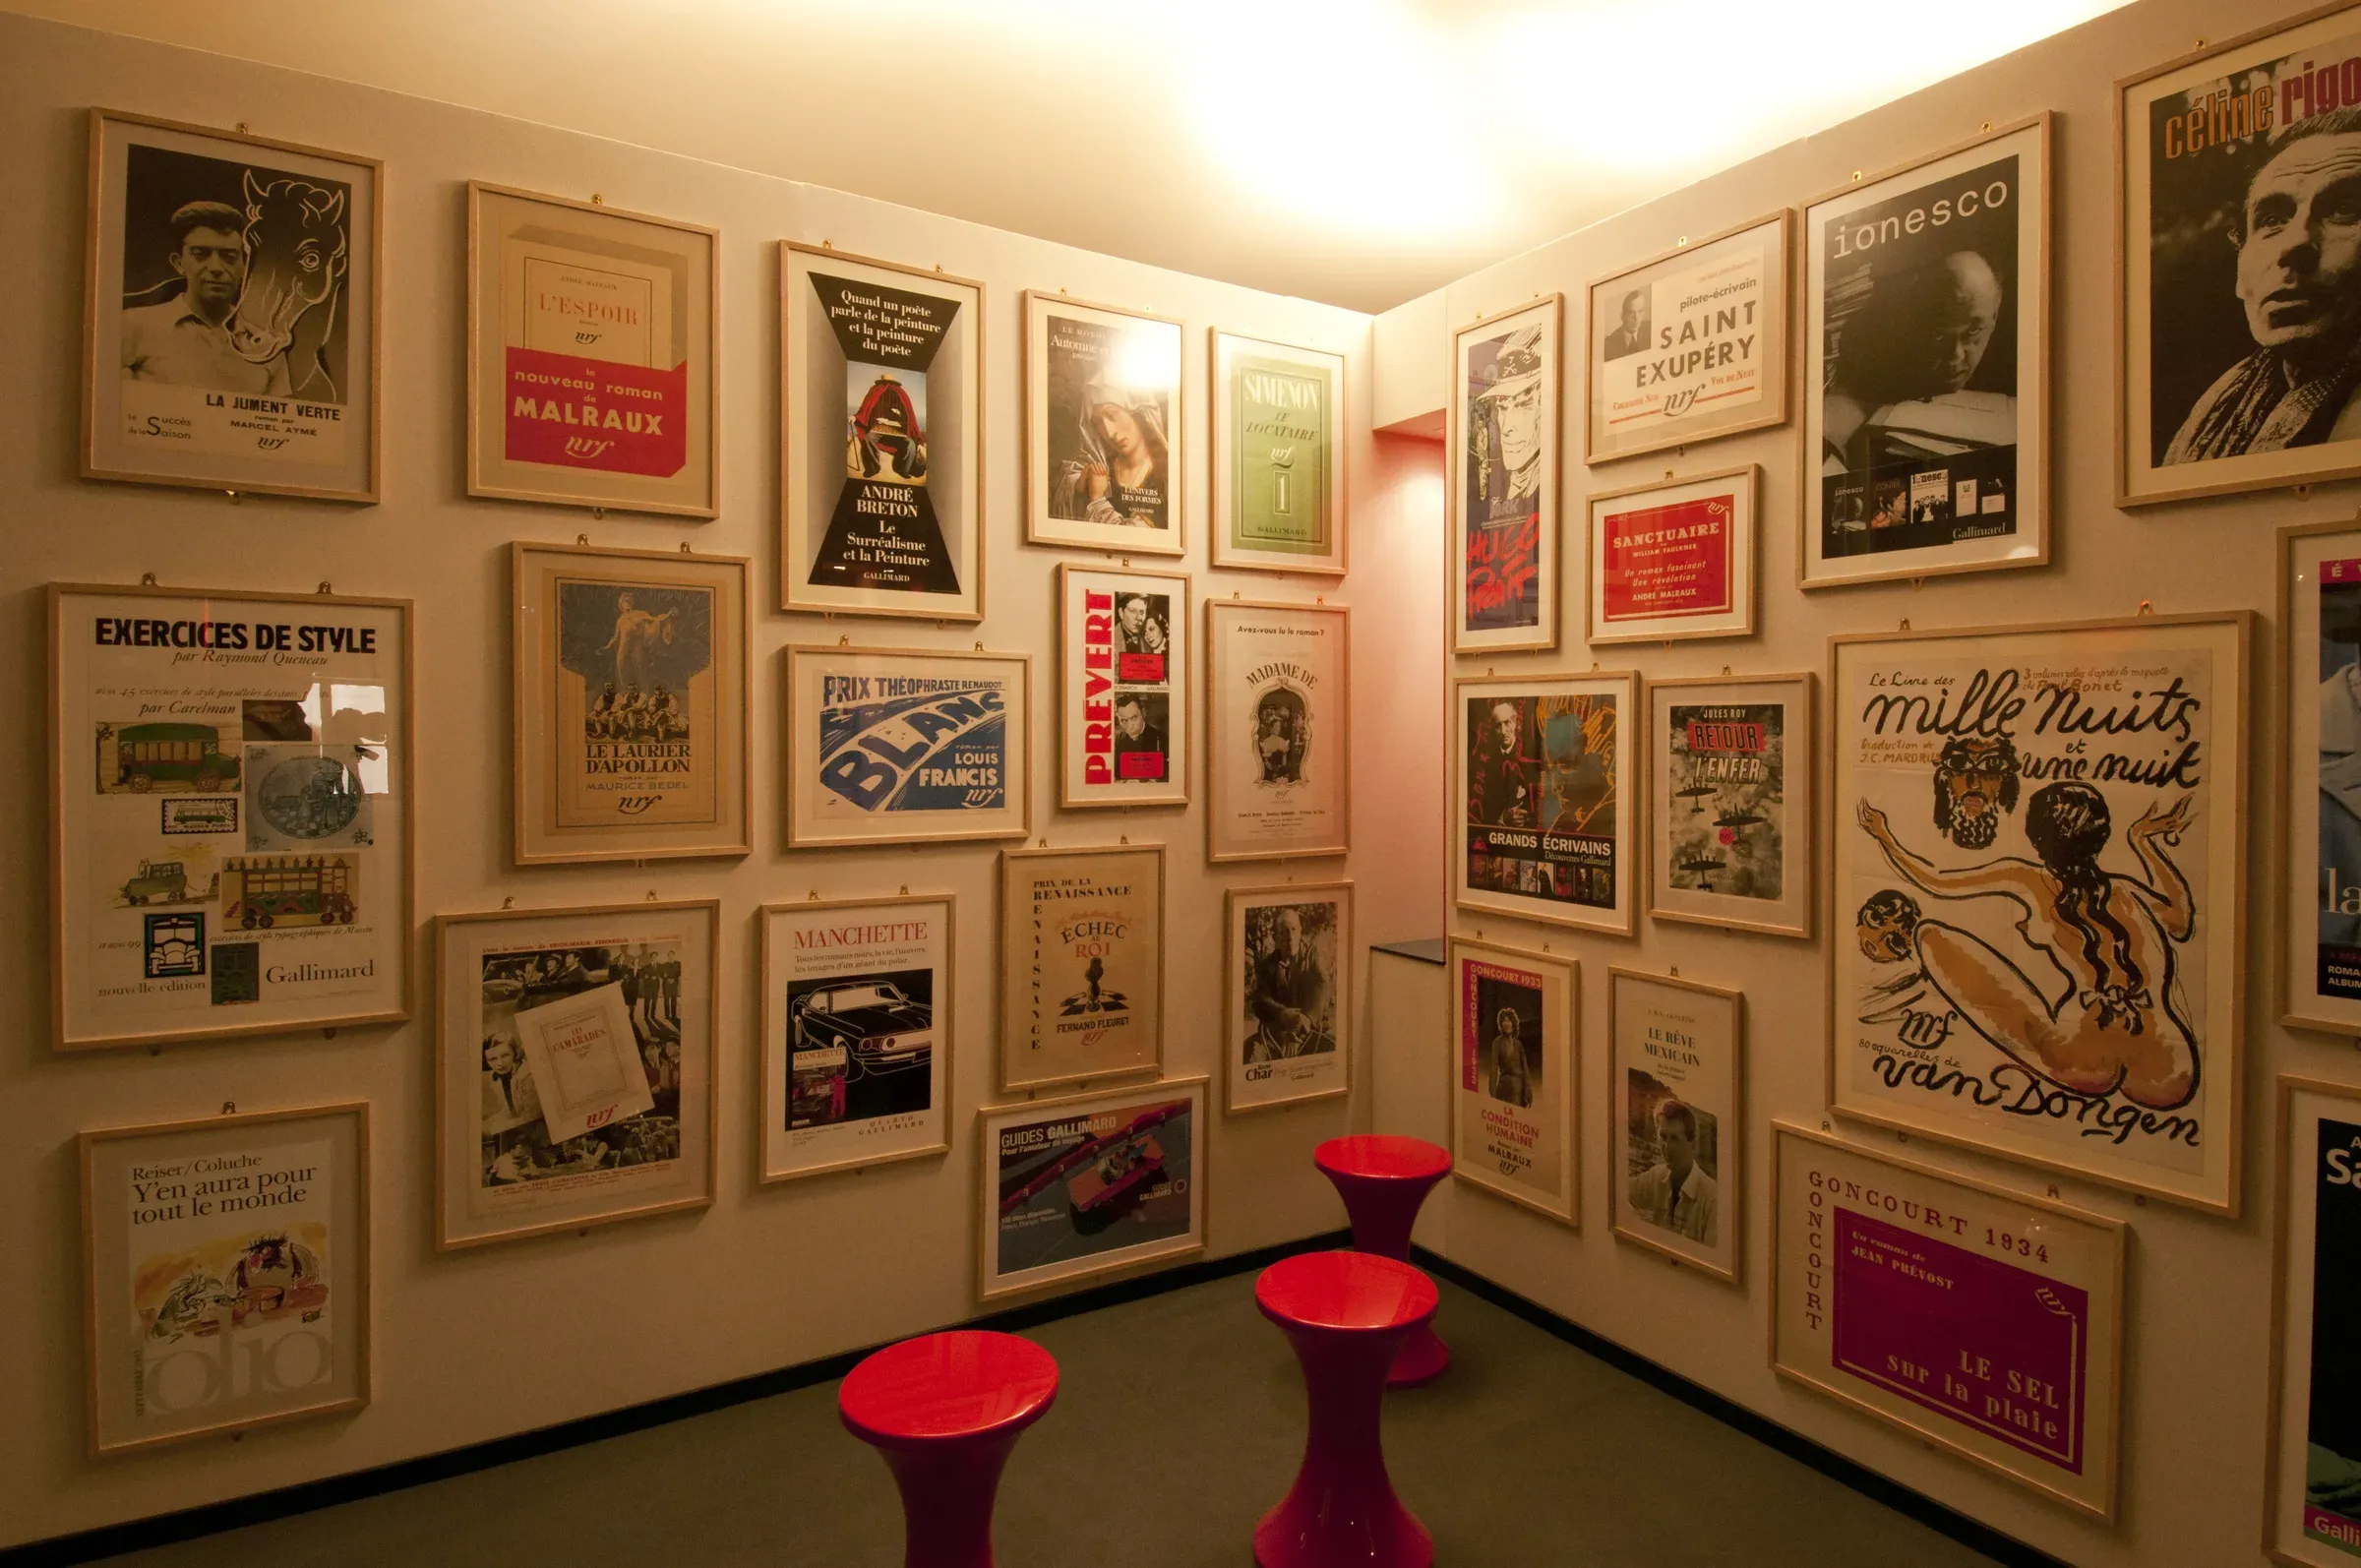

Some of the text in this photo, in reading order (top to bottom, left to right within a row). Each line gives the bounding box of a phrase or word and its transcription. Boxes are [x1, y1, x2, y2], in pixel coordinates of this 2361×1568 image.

[2165, 85, 2273, 159] céline
[1834, 181, 2008, 259] ionesco
[841, 289, 932, 321] Quand un poète
[1679, 277, 1757, 313] pilote-écrivain
[539, 293, 637, 327] L'ESPOIR
[830, 304, 941, 334] parle de la peinture
[849, 322, 925, 345] et la peinture
[1660, 300, 1756, 350] SAINT
[575, 332, 602, 345] nrf
[862, 339, 912, 358] du poète
[1636, 334, 1756, 389] EXUPÉRY
[515, 371, 664, 401] nouveau roman
[1244, 373, 1318, 411] SIMENON
[206, 393, 341, 421] LA JUMENT VERTE
[582, 394, 597, 403] de
[1664, 383, 1707, 417] nrf
[513, 395, 664, 436] MALRAUX
[1275, 412, 1291, 422] LE
[230, 420, 318, 437] MARCEL AYMÉ
[1245, 422, 1318, 442] LOCATAIRE
[258, 436, 290, 451] nrf
[564, 436, 616, 459] nrf
[862, 484, 914, 505] ANDRÉ
[856, 499, 918, 518] BRETON
[1707, 501, 1729, 515] nrf
[879, 519, 896, 535] Le
[1612, 521, 1720, 549] SANCTUAIRE
[1953, 522, 2007, 540] Gallimard
[847, 531, 926, 552] Surréalisme
[1633, 543, 1697, 558] WILLIAM FAULKNER
[843, 548, 930, 568] et la Peinture
[864, 571, 910, 583] GALLIMARD
[1638, 568, 1664, 576] roman
[1653, 573, 1697, 585] révélation
[1632, 588, 1697, 601] ANDRÉ MALRAUX
[95, 618, 377, 654] EXERCICES DE STYLE
[1237, 625, 1277, 635] Avez-vous
[172, 649, 329, 667] par Raymond Queneau
[1245, 662, 1318, 690] MADAME DE
[1868, 670, 1957, 688] Le Livre des
[823, 675, 1003, 706] PRIX THÉOPHRASTE RENAUDOT
[139, 700, 236, 717] par Carelman
[1703, 708, 1747, 719] JULES ROY
[1862, 669, 2027, 739] mille
[1694, 724, 1759, 750] RETOUR
[2065, 738, 2087, 754] et
[585, 744, 691, 759] LE LAURIER
[954, 753, 999, 765] LOUIS
[585, 758, 691, 775] D'APOLLON
[1694, 756, 1762, 784] L'ENFER
[2091, 740, 2202, 789] nuit
[585, 781, 690, 792] MAURICE BEDEL
[919, 768, 999, 787] FRANCIS
[617, 794, 663, 815] nrf
[960, 787, 1003, 809] nrf
[1488, 831, 1611, 857] GRANDS ÉCRIVAINS
[1544, 850, 1611, 867] Découvertes Gallimard
[1033, 879, 1056, 888] PRIX
[1033, 885, 1132, 901] RENAISSANCE
[793, 922, 929, 950] MANCHETTE
[1060, 921, 1128, 945] ÉCHEC
[1074, 941, 1111, 958] ROI
[266, 960, 375, 985] Gallimard
[1470, 964, 1543, 989] GONCOURT 1933
[98, 980, 206, 996] nouvelle édition
[1057, 1016, 1130, 1034] FERNAND FLEURET
[1649, 1027, 1696, 1050] LE RÊVE
[1644, 1043, 1700, 1066] MEXICAIN
[1245, 1068, 1273, 1082] Char
[586, 1103, 619, 1128] nrf
[1990, 1062, 2201, 1147] Dongen
[1001, 1116, 1118, 1149] GUIDES GALLIMARD
[1481, 1109, 1541, 1139] CONDITION
[1485, 1123, 1534, 1149] HUMAINE
[132, 1154, 262, 1181] Reiser/Coluche
[1487, 1144, 1532, 1169] MALRAUX
[133, 1165, 318, 1204] Y'en aura pour
[133, 1185, 307, 1226] tout le monde
[1809, 1171, 2049, 1264] GONCOURT 1934
[1850, 1230, 1927, 1263] Un roman de
[1850, 1245, 1955, 1291] JEAN PRÉVOST
[1959, 1349, 2059, 1410] LE SEL
[1888, 1354, 2058, 1440] sur la plaie
